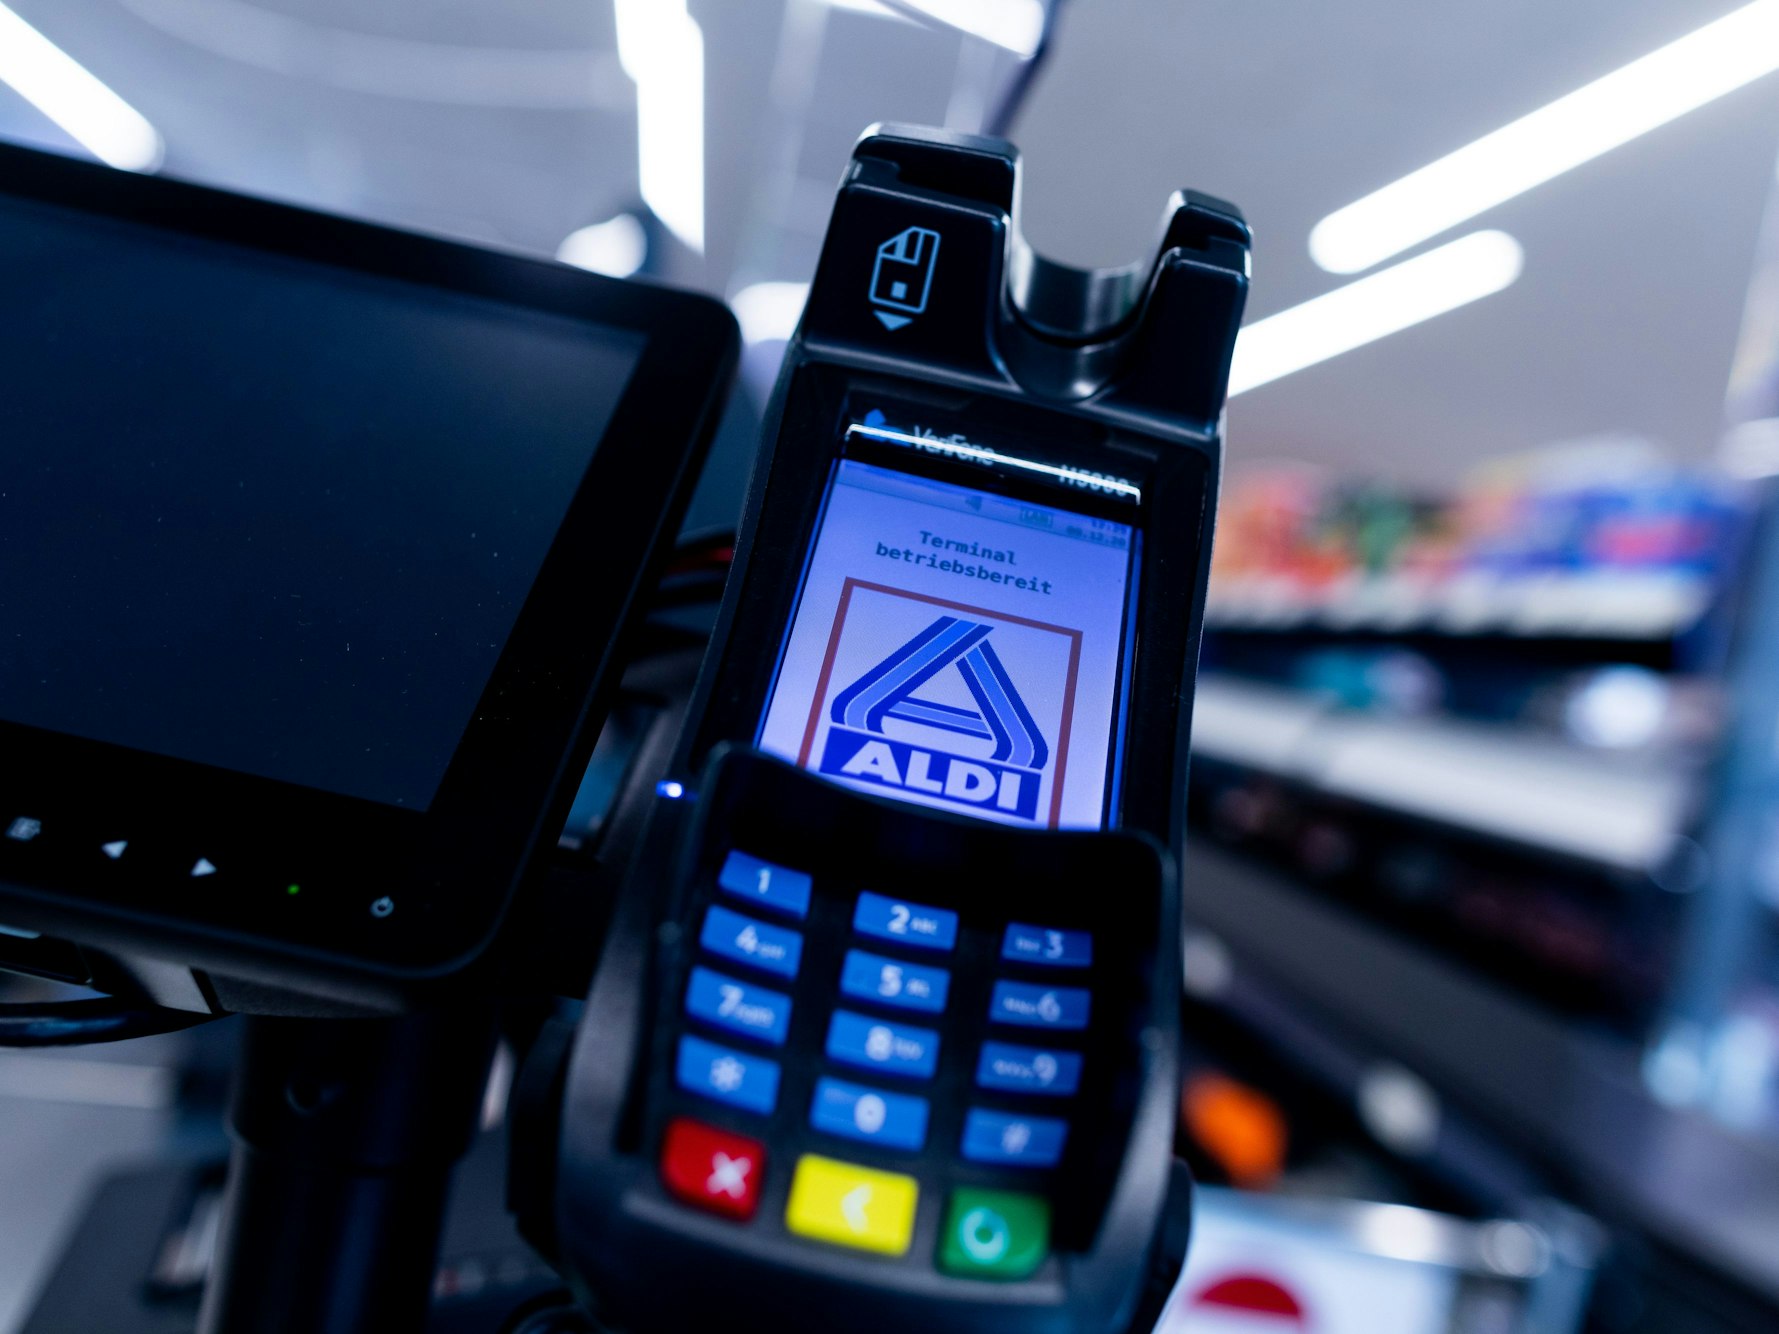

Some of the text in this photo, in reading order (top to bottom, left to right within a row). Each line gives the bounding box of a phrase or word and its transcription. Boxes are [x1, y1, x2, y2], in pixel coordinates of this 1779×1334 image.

[919, 530, 1017, 566] Terminal
[875, 541, 1053, 595] betriebsbereit
[840, 740, 1022, 812] ALDI
[758, 867, 771, 895] 1
[887, 904, 910, 935] 2
[735, 924, 759, 955] 4
[1045, 929, 1064, 960] 3
[877, 964, 903, 998] 5
[717, 983, 745, 1018] 7
[1036, 991, 1061, 1023] 6
[1033, 1053, 1058, 1087] 9
[854, 1093, 886, 1134] 0
